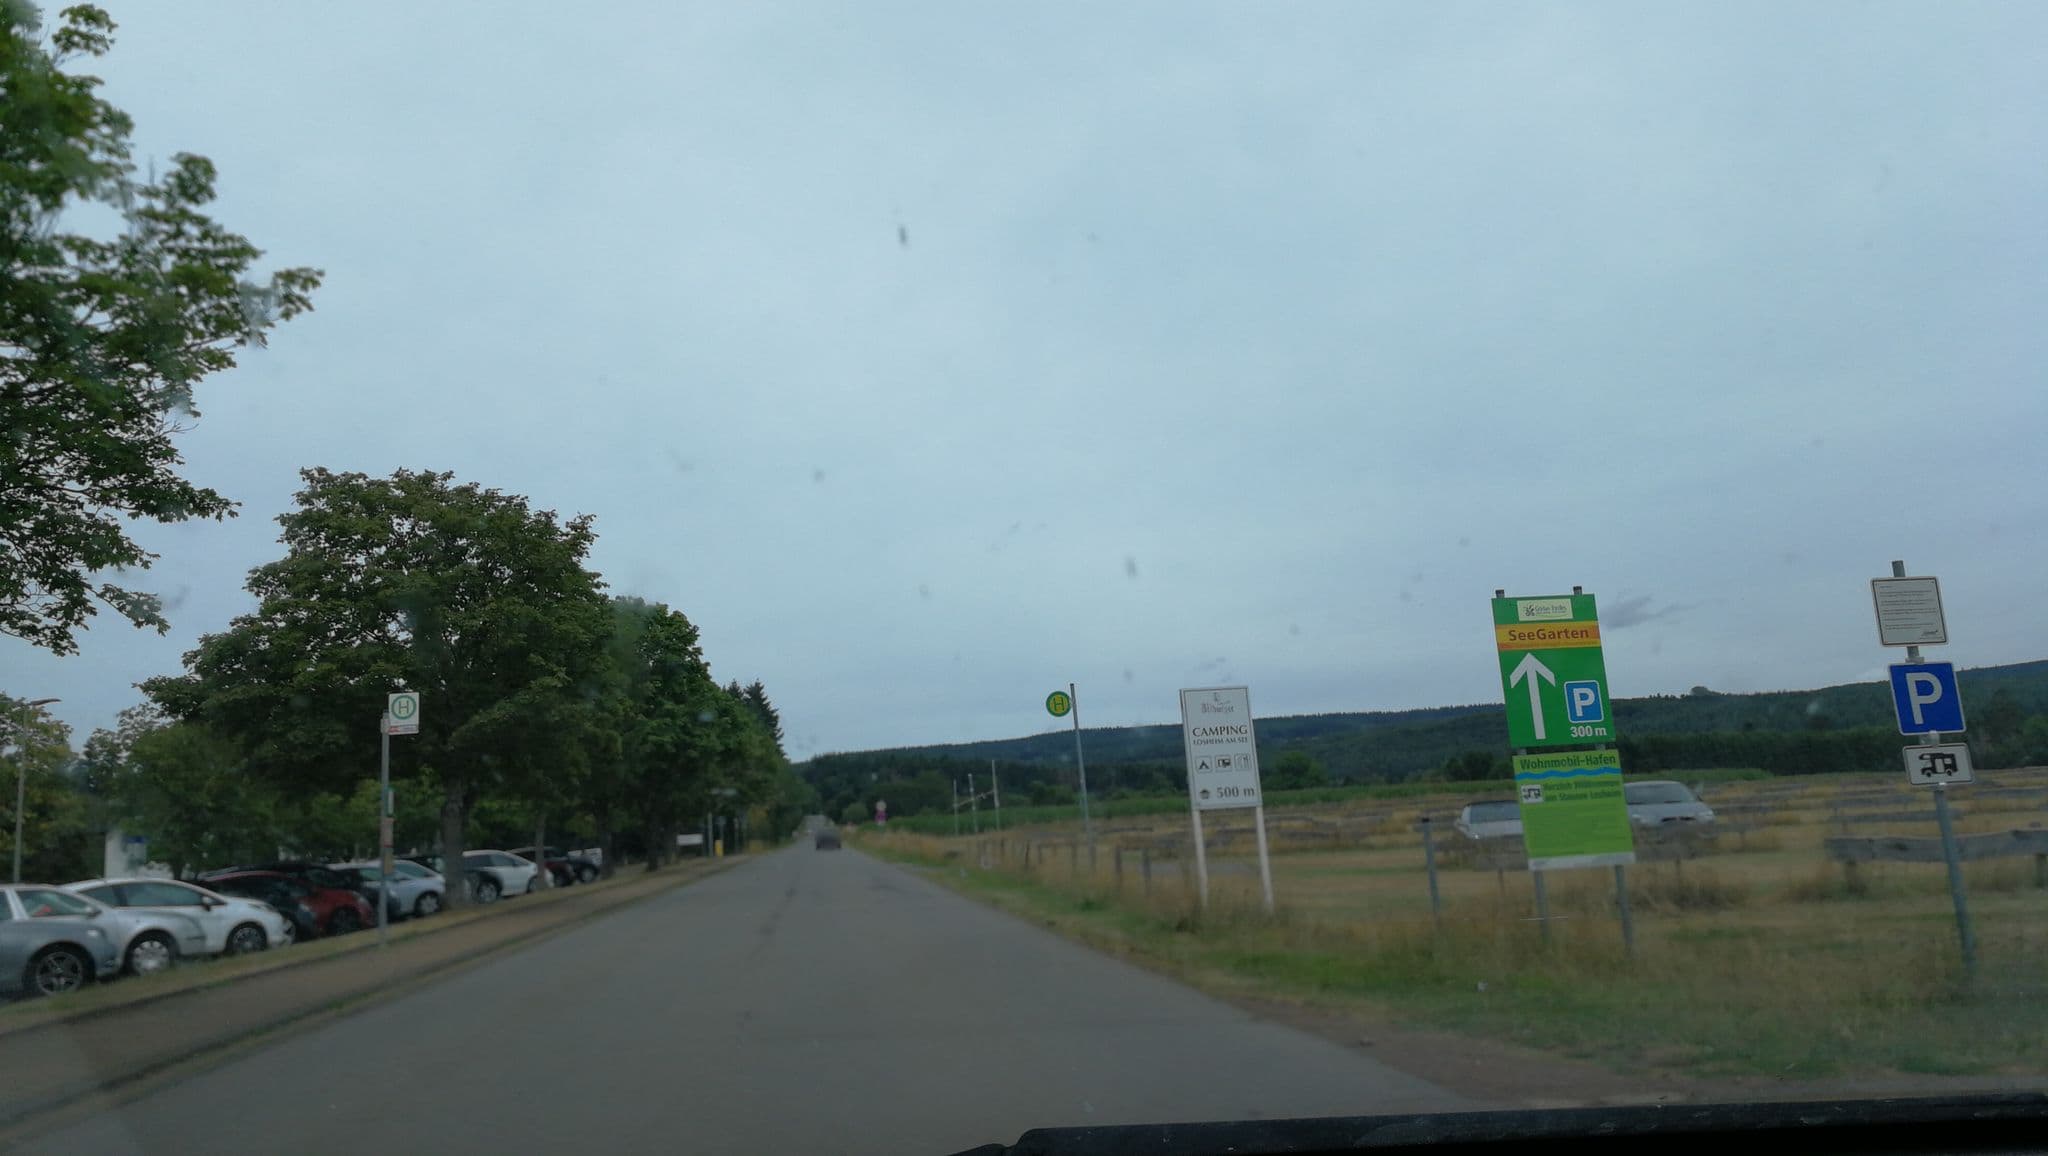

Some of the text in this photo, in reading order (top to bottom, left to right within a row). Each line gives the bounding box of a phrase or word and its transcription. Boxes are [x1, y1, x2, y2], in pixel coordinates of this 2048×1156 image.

[1508, 628, 1589, 642] SeeGarten
[1573, 687, 1595, 717] P
[1905, 672, 1943, 725] P
[1192, 725, 1248, 737] CAMPING
[1570, 726, 1607, 738] 300 m
[1520, 754, 1616, 770] Wohnmobil-Hafen
[1216, 786, 1255, 799] 500 m
